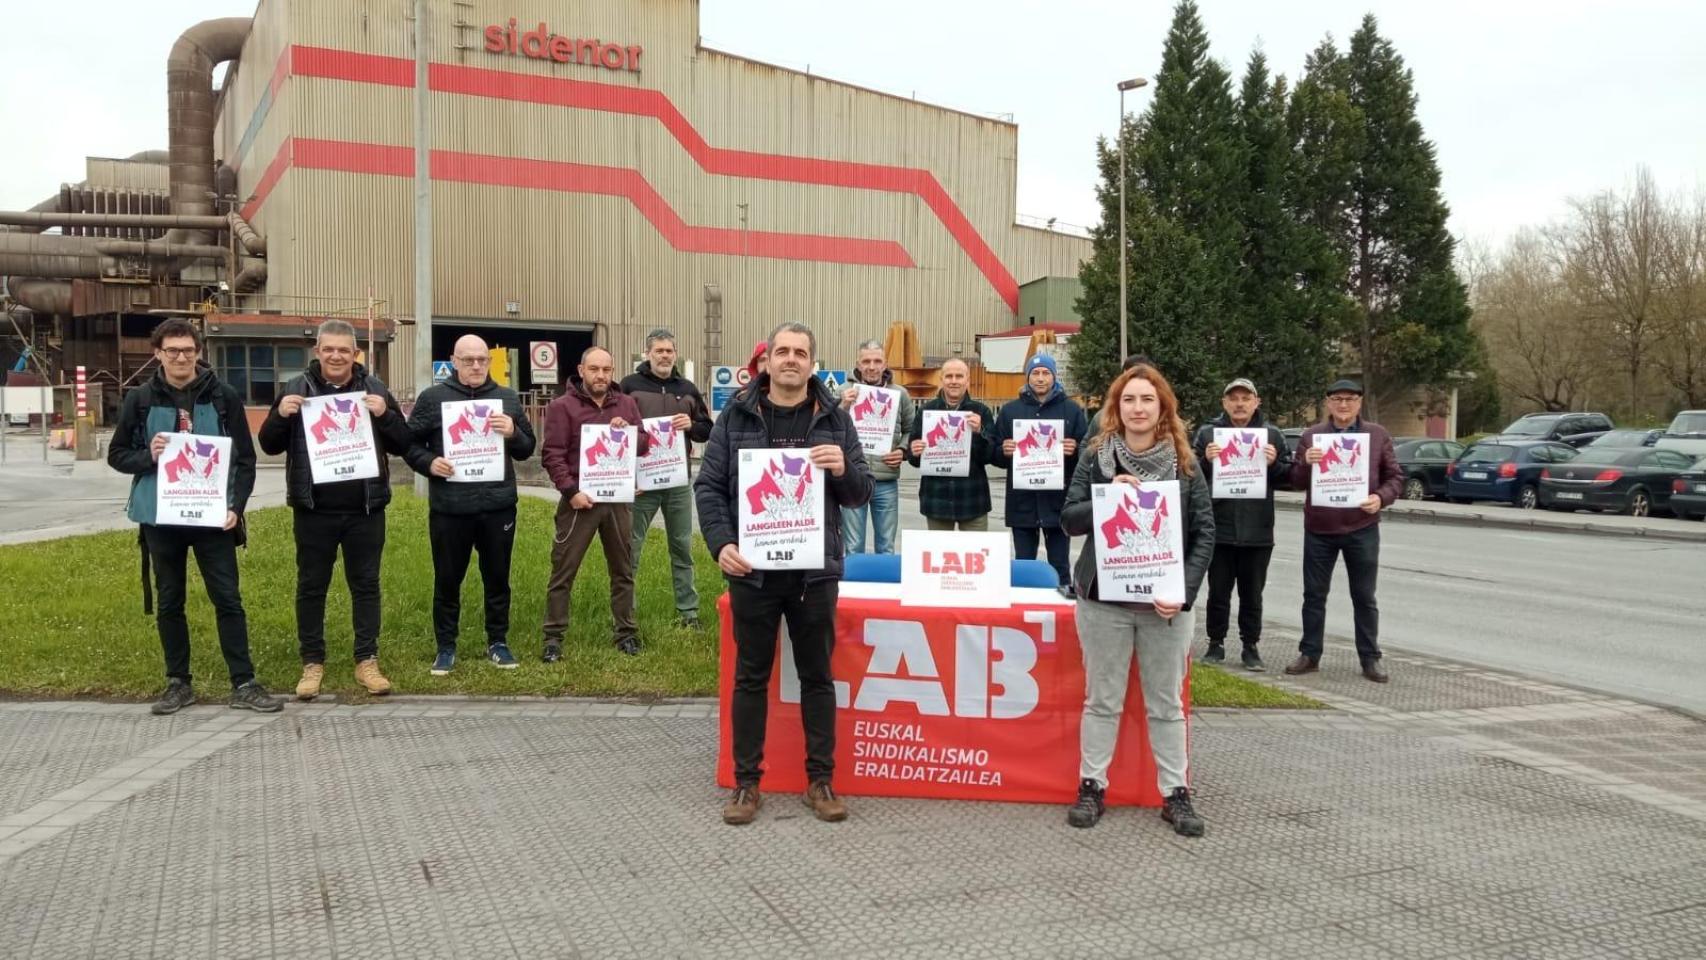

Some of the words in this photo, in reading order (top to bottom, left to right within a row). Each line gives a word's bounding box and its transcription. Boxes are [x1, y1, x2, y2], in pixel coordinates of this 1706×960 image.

[484, 17, 643, 71] sidenor
[541, 351, 548, 361] 5
[334, 465, 356, 475] LAB
[202, 488, 219, 496] ALDE
[180, 510, 203, 518] LAB
[746, 520, 793, 532] LANGILEEN
[794, 518, 816, 527] ALDE
[767, 549, 795, 561] LAB
[922, 549, 988, 574] LAB
[1103, 555, 1150, 565] LANGILEEN
[1151, 551, 1174, 561] ALDE
[1126, 584, 1154, 594] LAB
[853, 721, 925, 742] EUSKAL
[853, 741, 989, 766] SINDIKALISMO
[853, 760, 1002, 787] ERALDATZAILEA
